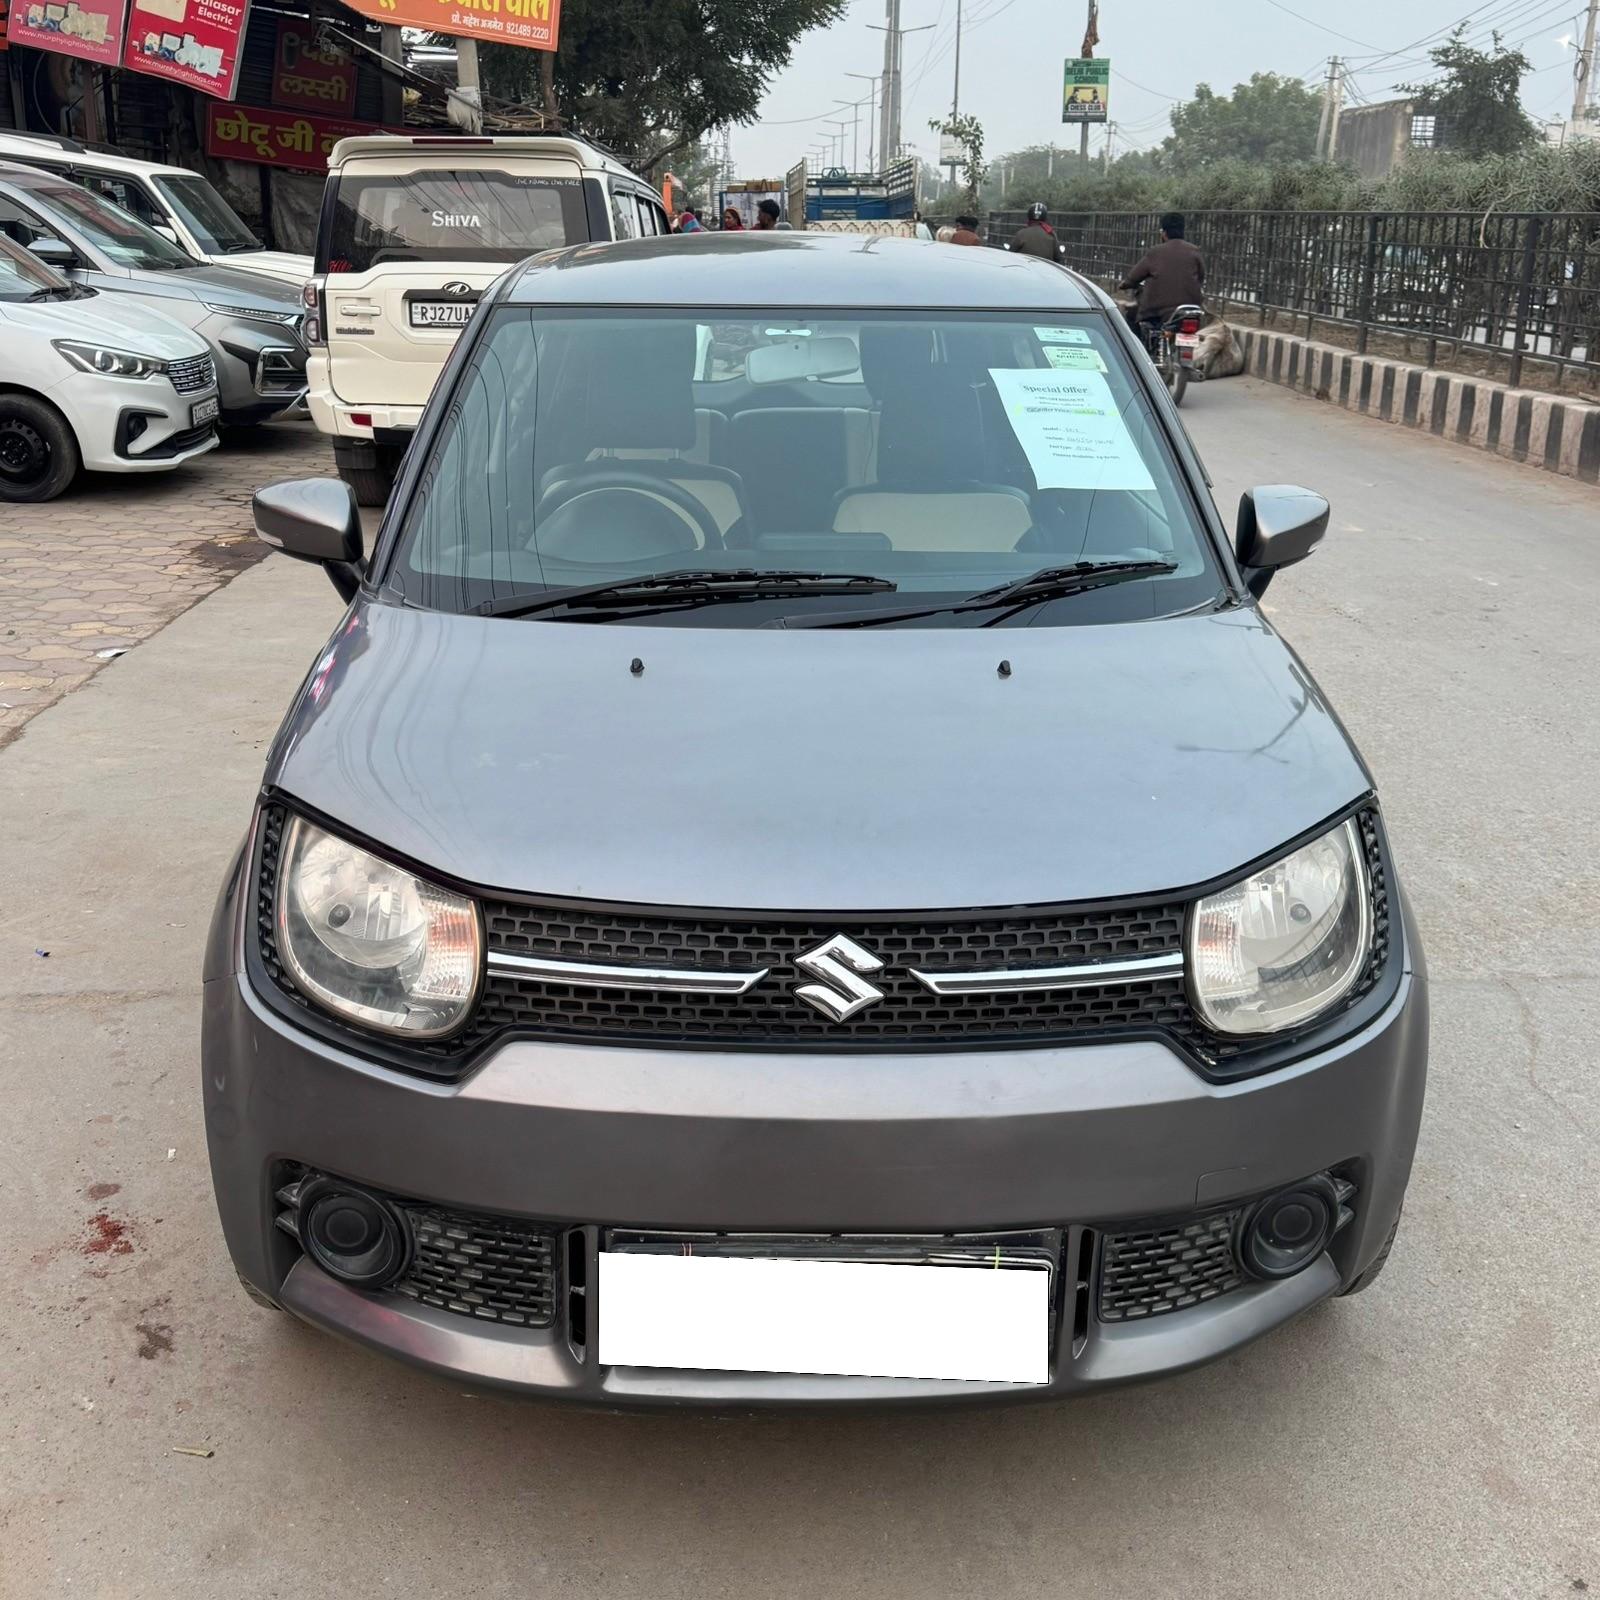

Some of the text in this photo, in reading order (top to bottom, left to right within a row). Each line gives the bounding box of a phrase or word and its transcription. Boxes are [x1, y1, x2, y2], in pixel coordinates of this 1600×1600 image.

[193, 0, 242, 16] alasar
[197, 6, 233, 25] Electric
[18, 29, 111, 55] www.murphylightings.com
[530, 27, 549, 40] 2220
[133, 55, 223, 88] www.murphylightings.com
[279, 73, 349, 102] लस्सी
[215, 110, 276, 158] छोटू
[275, 120, 315, 153] जी
[431, 210, 482, 228] SHIVA
[420, 305, 474, 322] RJ27UA
[1023, 384, 1089, 394] Special Offer
